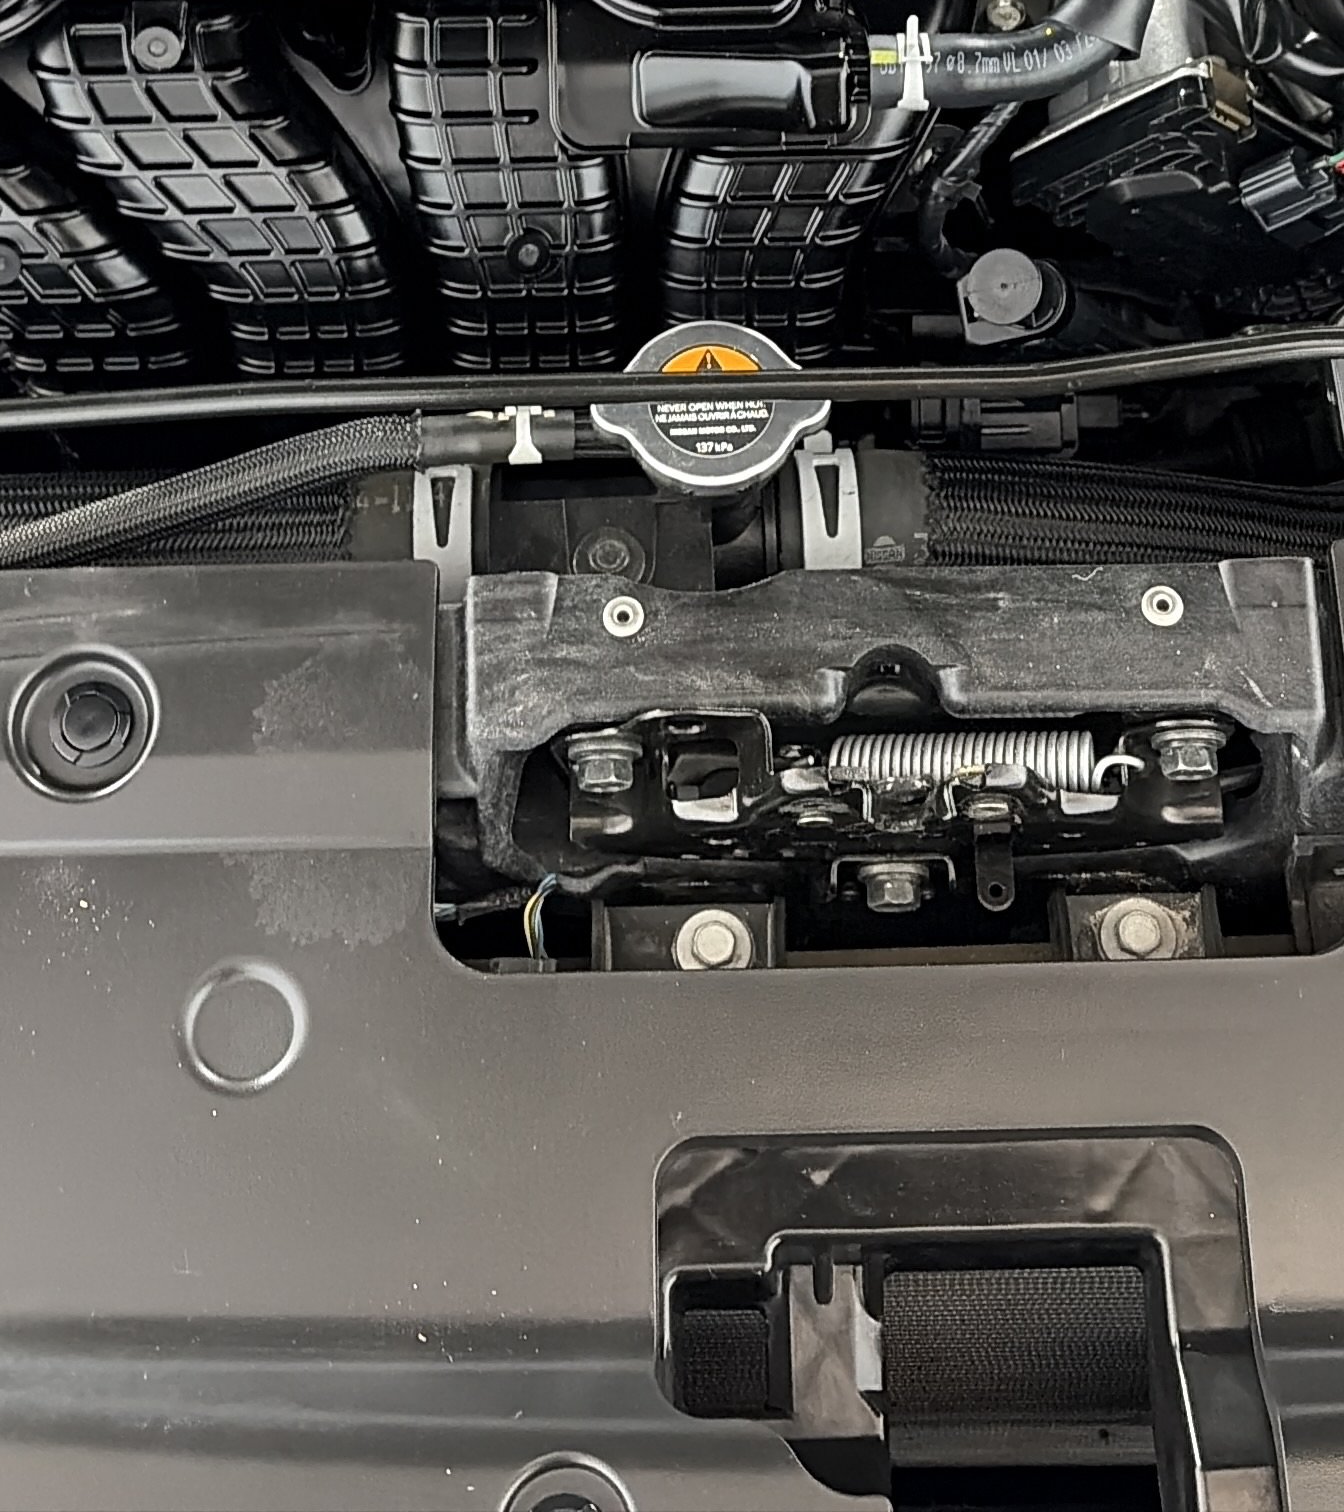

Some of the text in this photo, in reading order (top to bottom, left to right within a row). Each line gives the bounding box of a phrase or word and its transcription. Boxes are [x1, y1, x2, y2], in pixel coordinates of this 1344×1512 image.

[656, 403, 687, 413] NEVER
[688, 401, 714, 412] OPEN
[715, 400, 744, 411] WHEN
[655, 413, 668, 423] NE
[667, 412, 698, 423] JAMAIS
[698, 411, 730, 421] OUVRIR
[695, 441, 734, 453] 137 kPa
